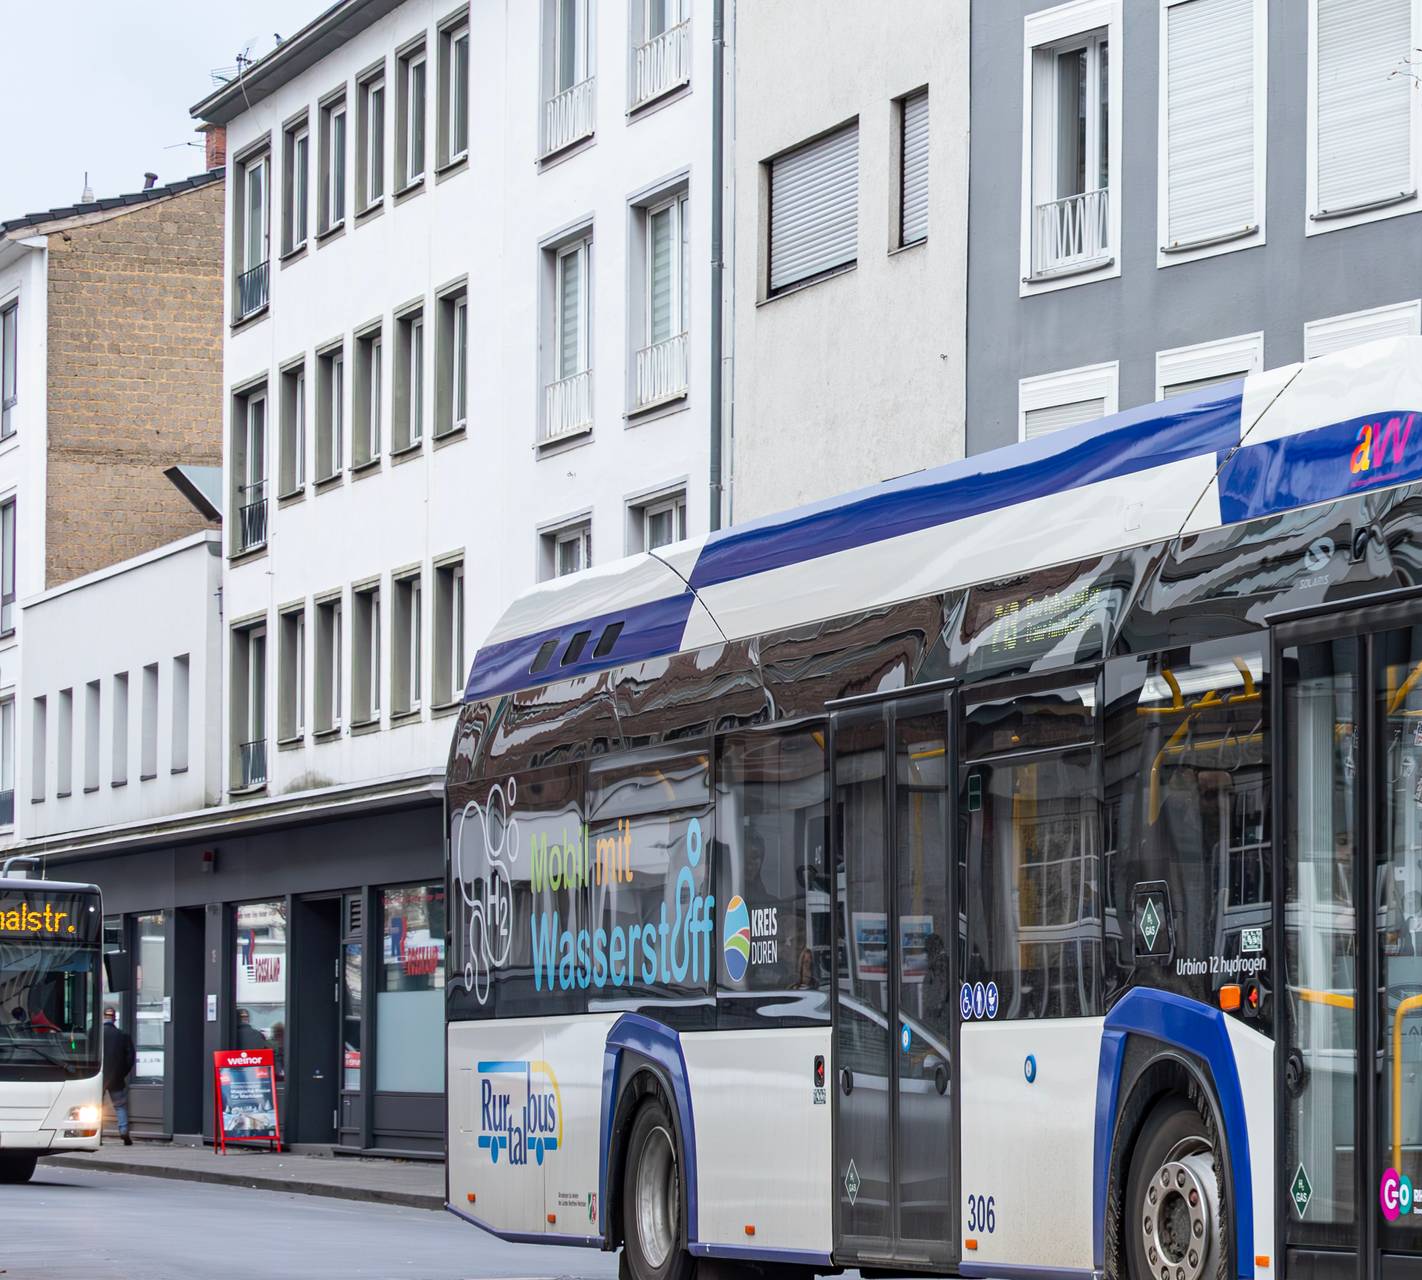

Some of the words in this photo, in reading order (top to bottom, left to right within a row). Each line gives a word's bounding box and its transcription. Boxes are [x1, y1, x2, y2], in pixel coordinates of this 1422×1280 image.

[1299, 574, 1329, 590] SOLARIS
[530, 824, 589, 894] Mobil
[596, 816, 634, 887] mit
[530, 866, 715, 993] Wasserstoff
[751, 906, 778, 937] KREIS
[751, 939, 778, 966] DÜREN
[1176, 957, 1207, 976] Urbino
[1209, 956, 1219, 974] 12
[1220, 955, 1267, 977] hydrogen
[227, 1052, 263, 1065] weinor
[1296, 1191, 1307, 1203] GAS
[967, 1193, 996, 1233] 306
